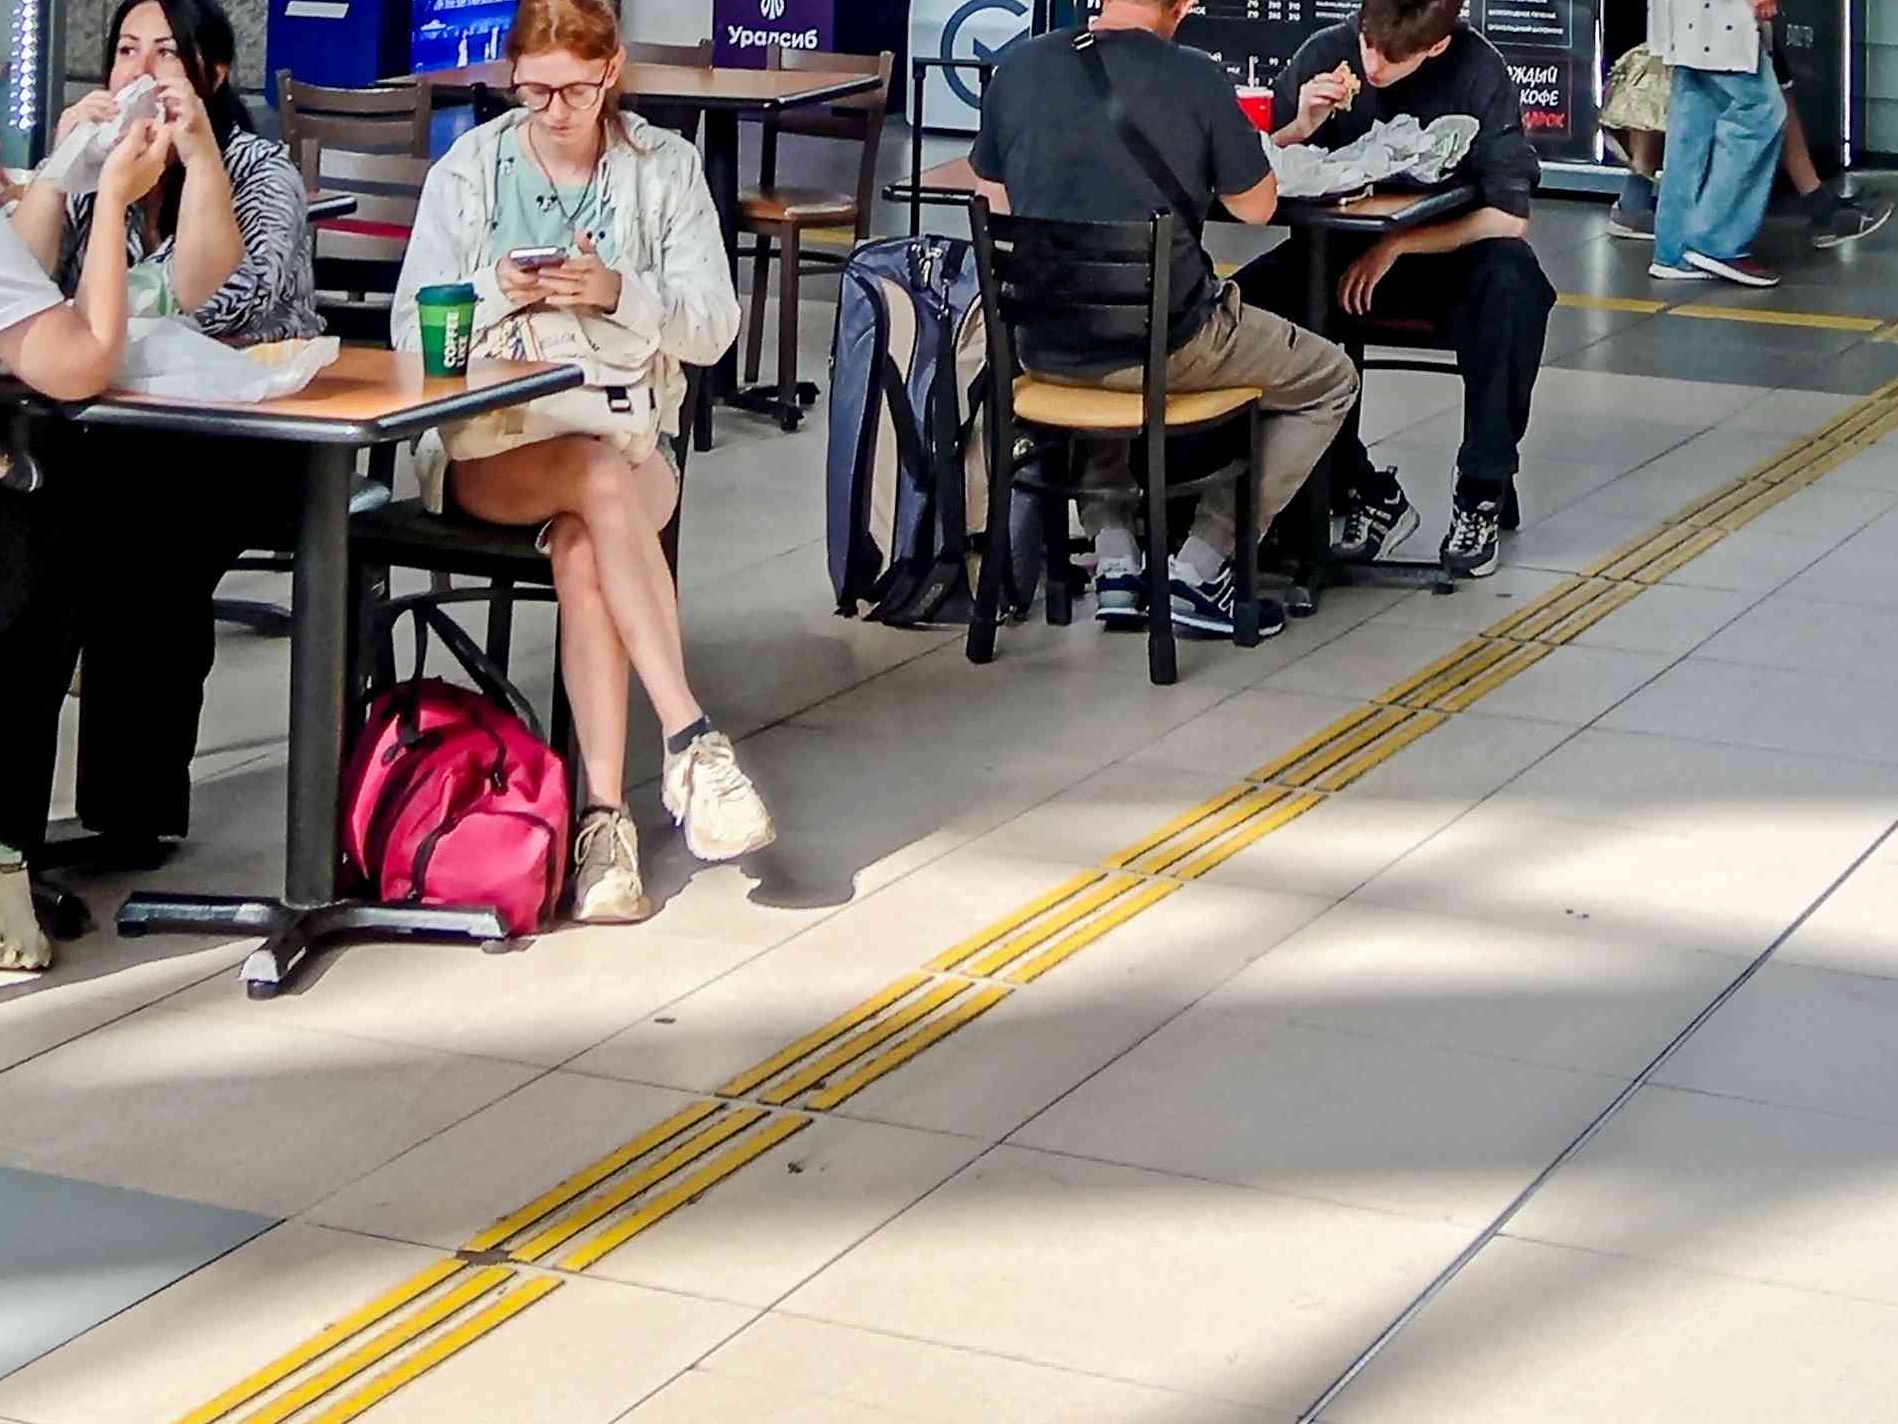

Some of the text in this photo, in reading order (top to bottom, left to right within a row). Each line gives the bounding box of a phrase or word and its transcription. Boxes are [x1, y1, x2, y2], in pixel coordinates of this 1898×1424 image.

[728, 25, 819, 50] Уралсиб
[1507, 65, 1559, 88] ЖДЫЙ
[1519, 89, 1560, 106] КОФЕ
[444, 312, 459, 368] COFFEE
